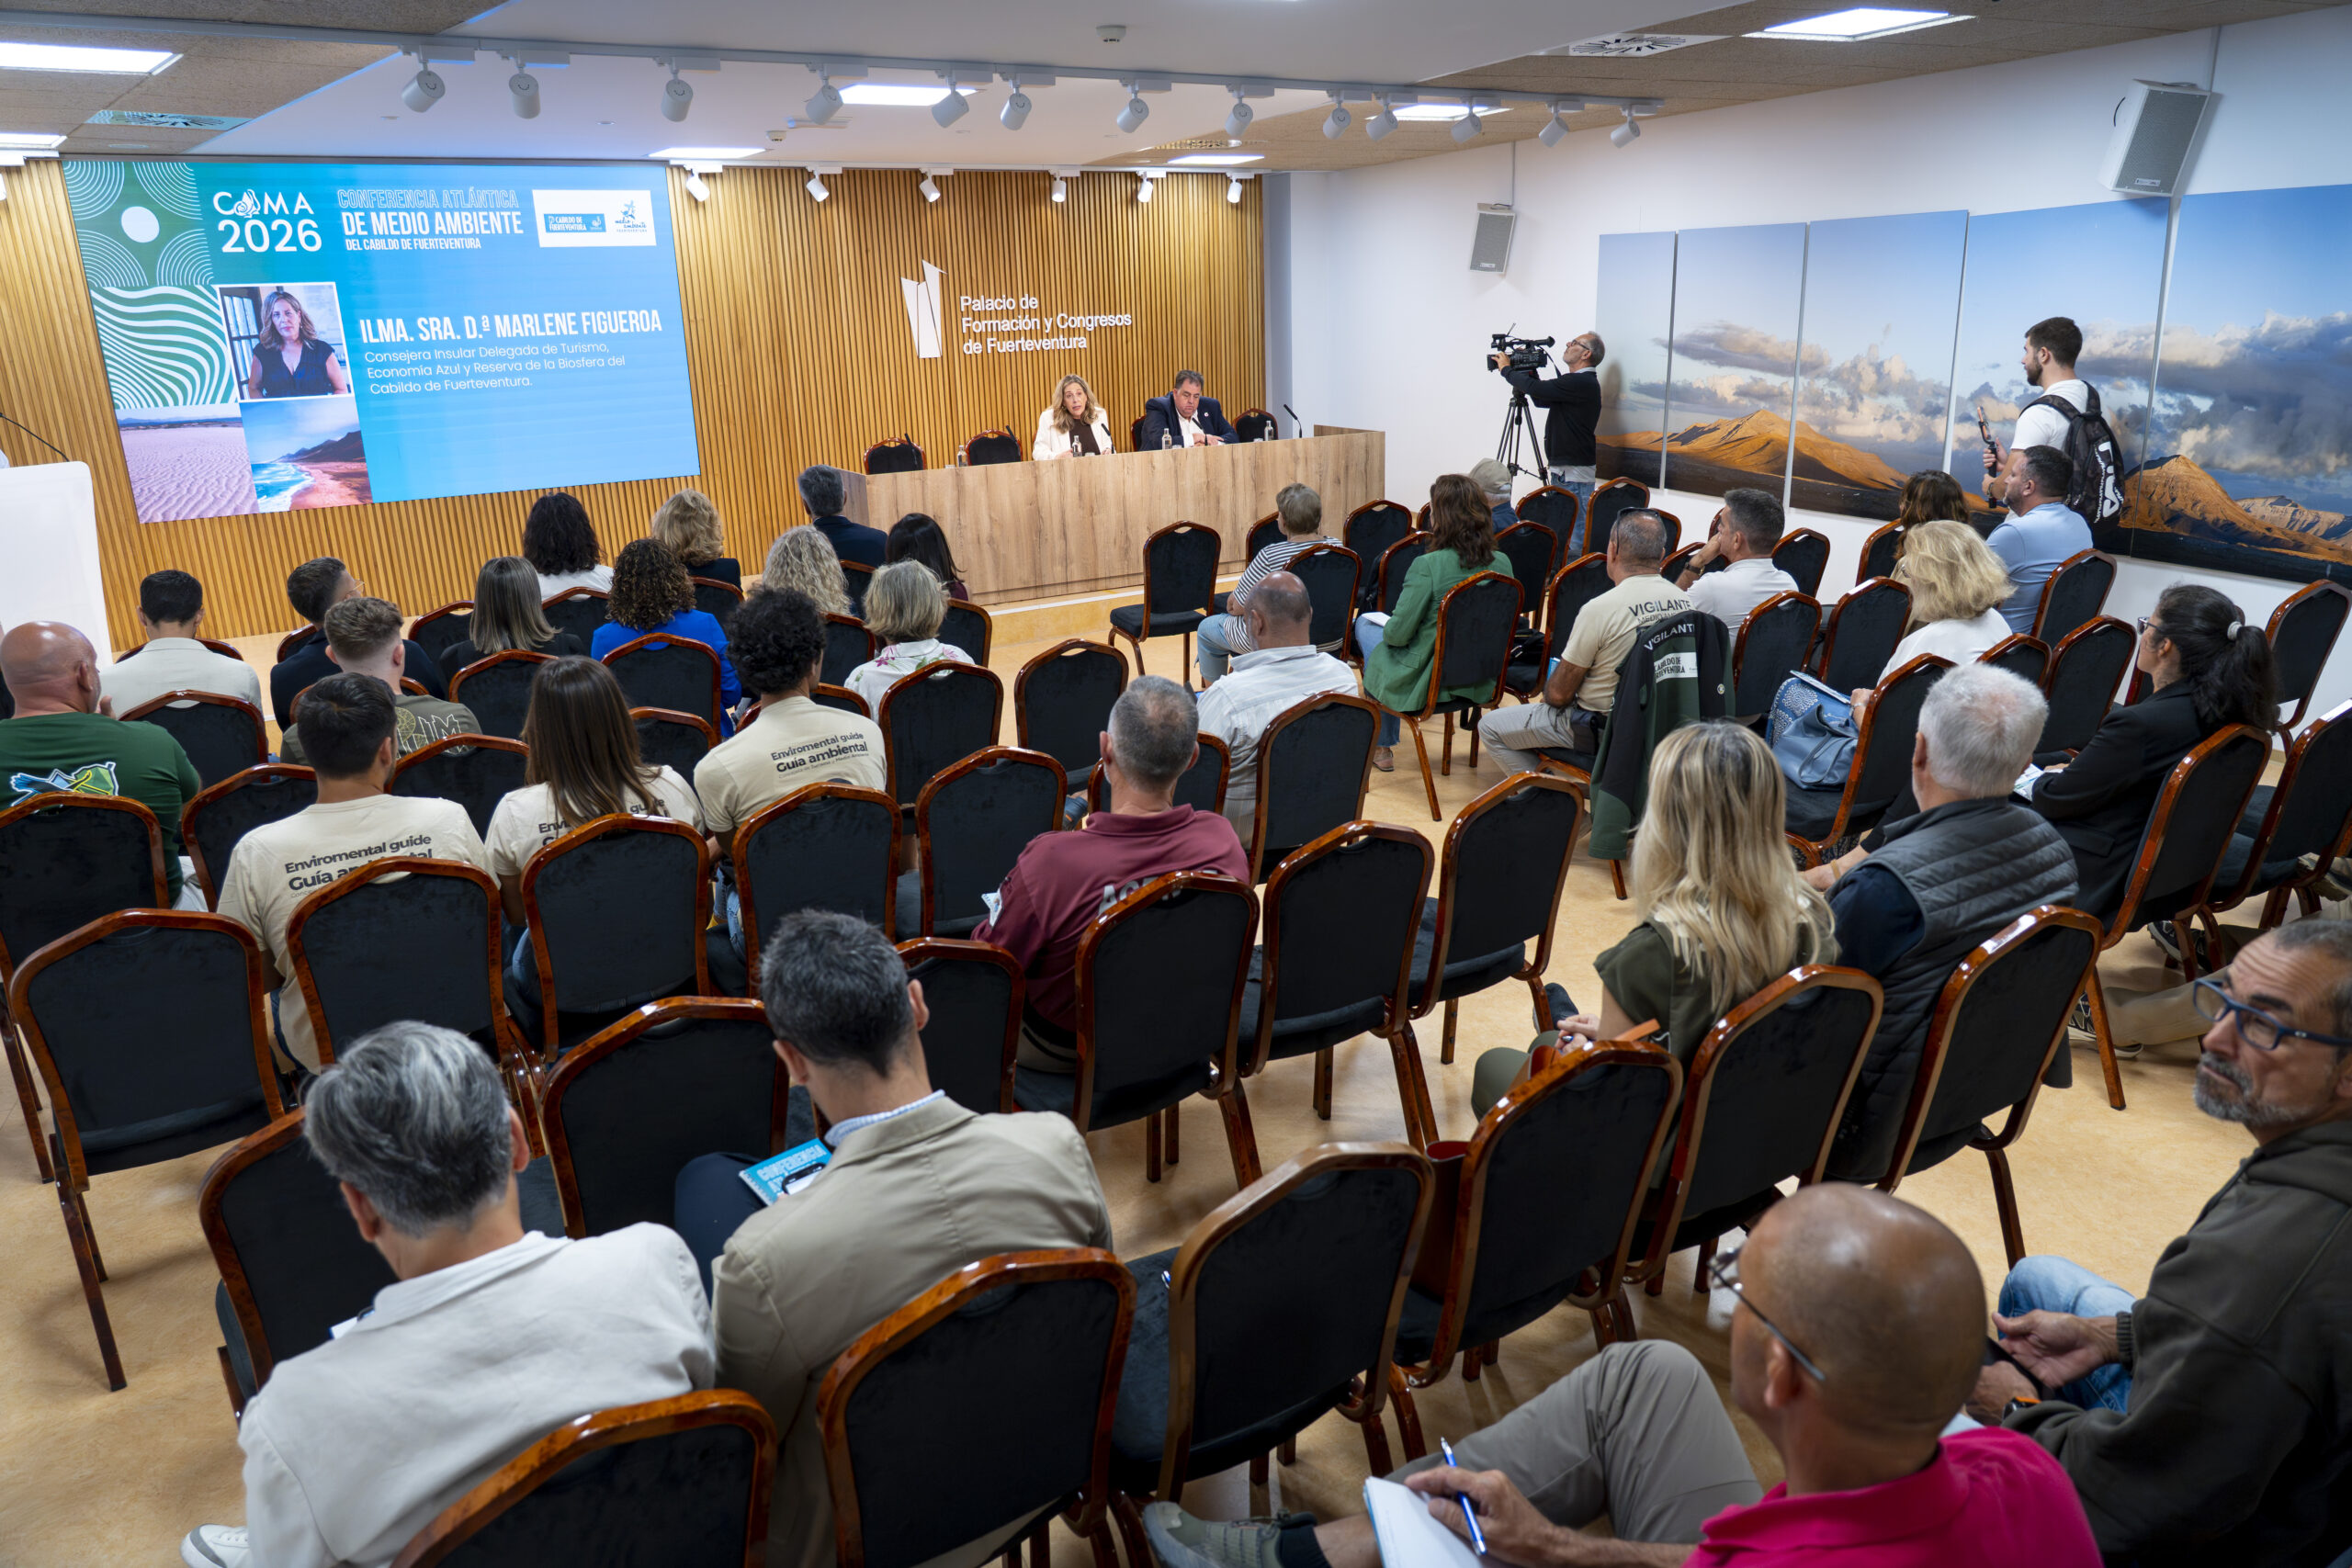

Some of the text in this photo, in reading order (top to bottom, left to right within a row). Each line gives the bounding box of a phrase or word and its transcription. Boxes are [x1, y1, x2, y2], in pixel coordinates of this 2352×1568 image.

[338, 186, 519, 209] CONFERENCIA ATLÁNTICA
[342, 211, 524, 235] DE MEDIO AMBIENTE
[218, 219, 322, 253] 2026
[345, 238, 481, 251] DEL CABILDO DE FUERTEVENTURA
[960, 294, 1038, 311] Palacio de
[359, 318, 414, 344] ILMA.
[417, 316, 461, 342] SRA.
[494, 312, 578, 338] MARLENE
[581, 310, 662, 334] FIGUEROA
[962, 313, 1132, 333] Formación y Congresos
[365, 342, 609, 364] Consejera Insular Delegada de Turismo,
[963, 335, 1087, 355] de Fuerteventura
[368, 355, 626, 378] Economía Azul y Reserva de la Biosfera del
[370, 377, 533, 395] Cabildo de Fuerteventura.
[1629, 600, 1691, 616] VIGILANTE
[1644, 624, 1694, 650] VGILANT
[1655, 657, 1675, 671] ABILDO
[771, 732, 864, 761] Enviromental guide
[808, 741, 868, 763] ambiental
[630, 799, 664, 814] gue
[285, 842, 386, 874] Enviromental
[390, 834, 432, 852] guide
[288, 870, 334, 891] Guía
